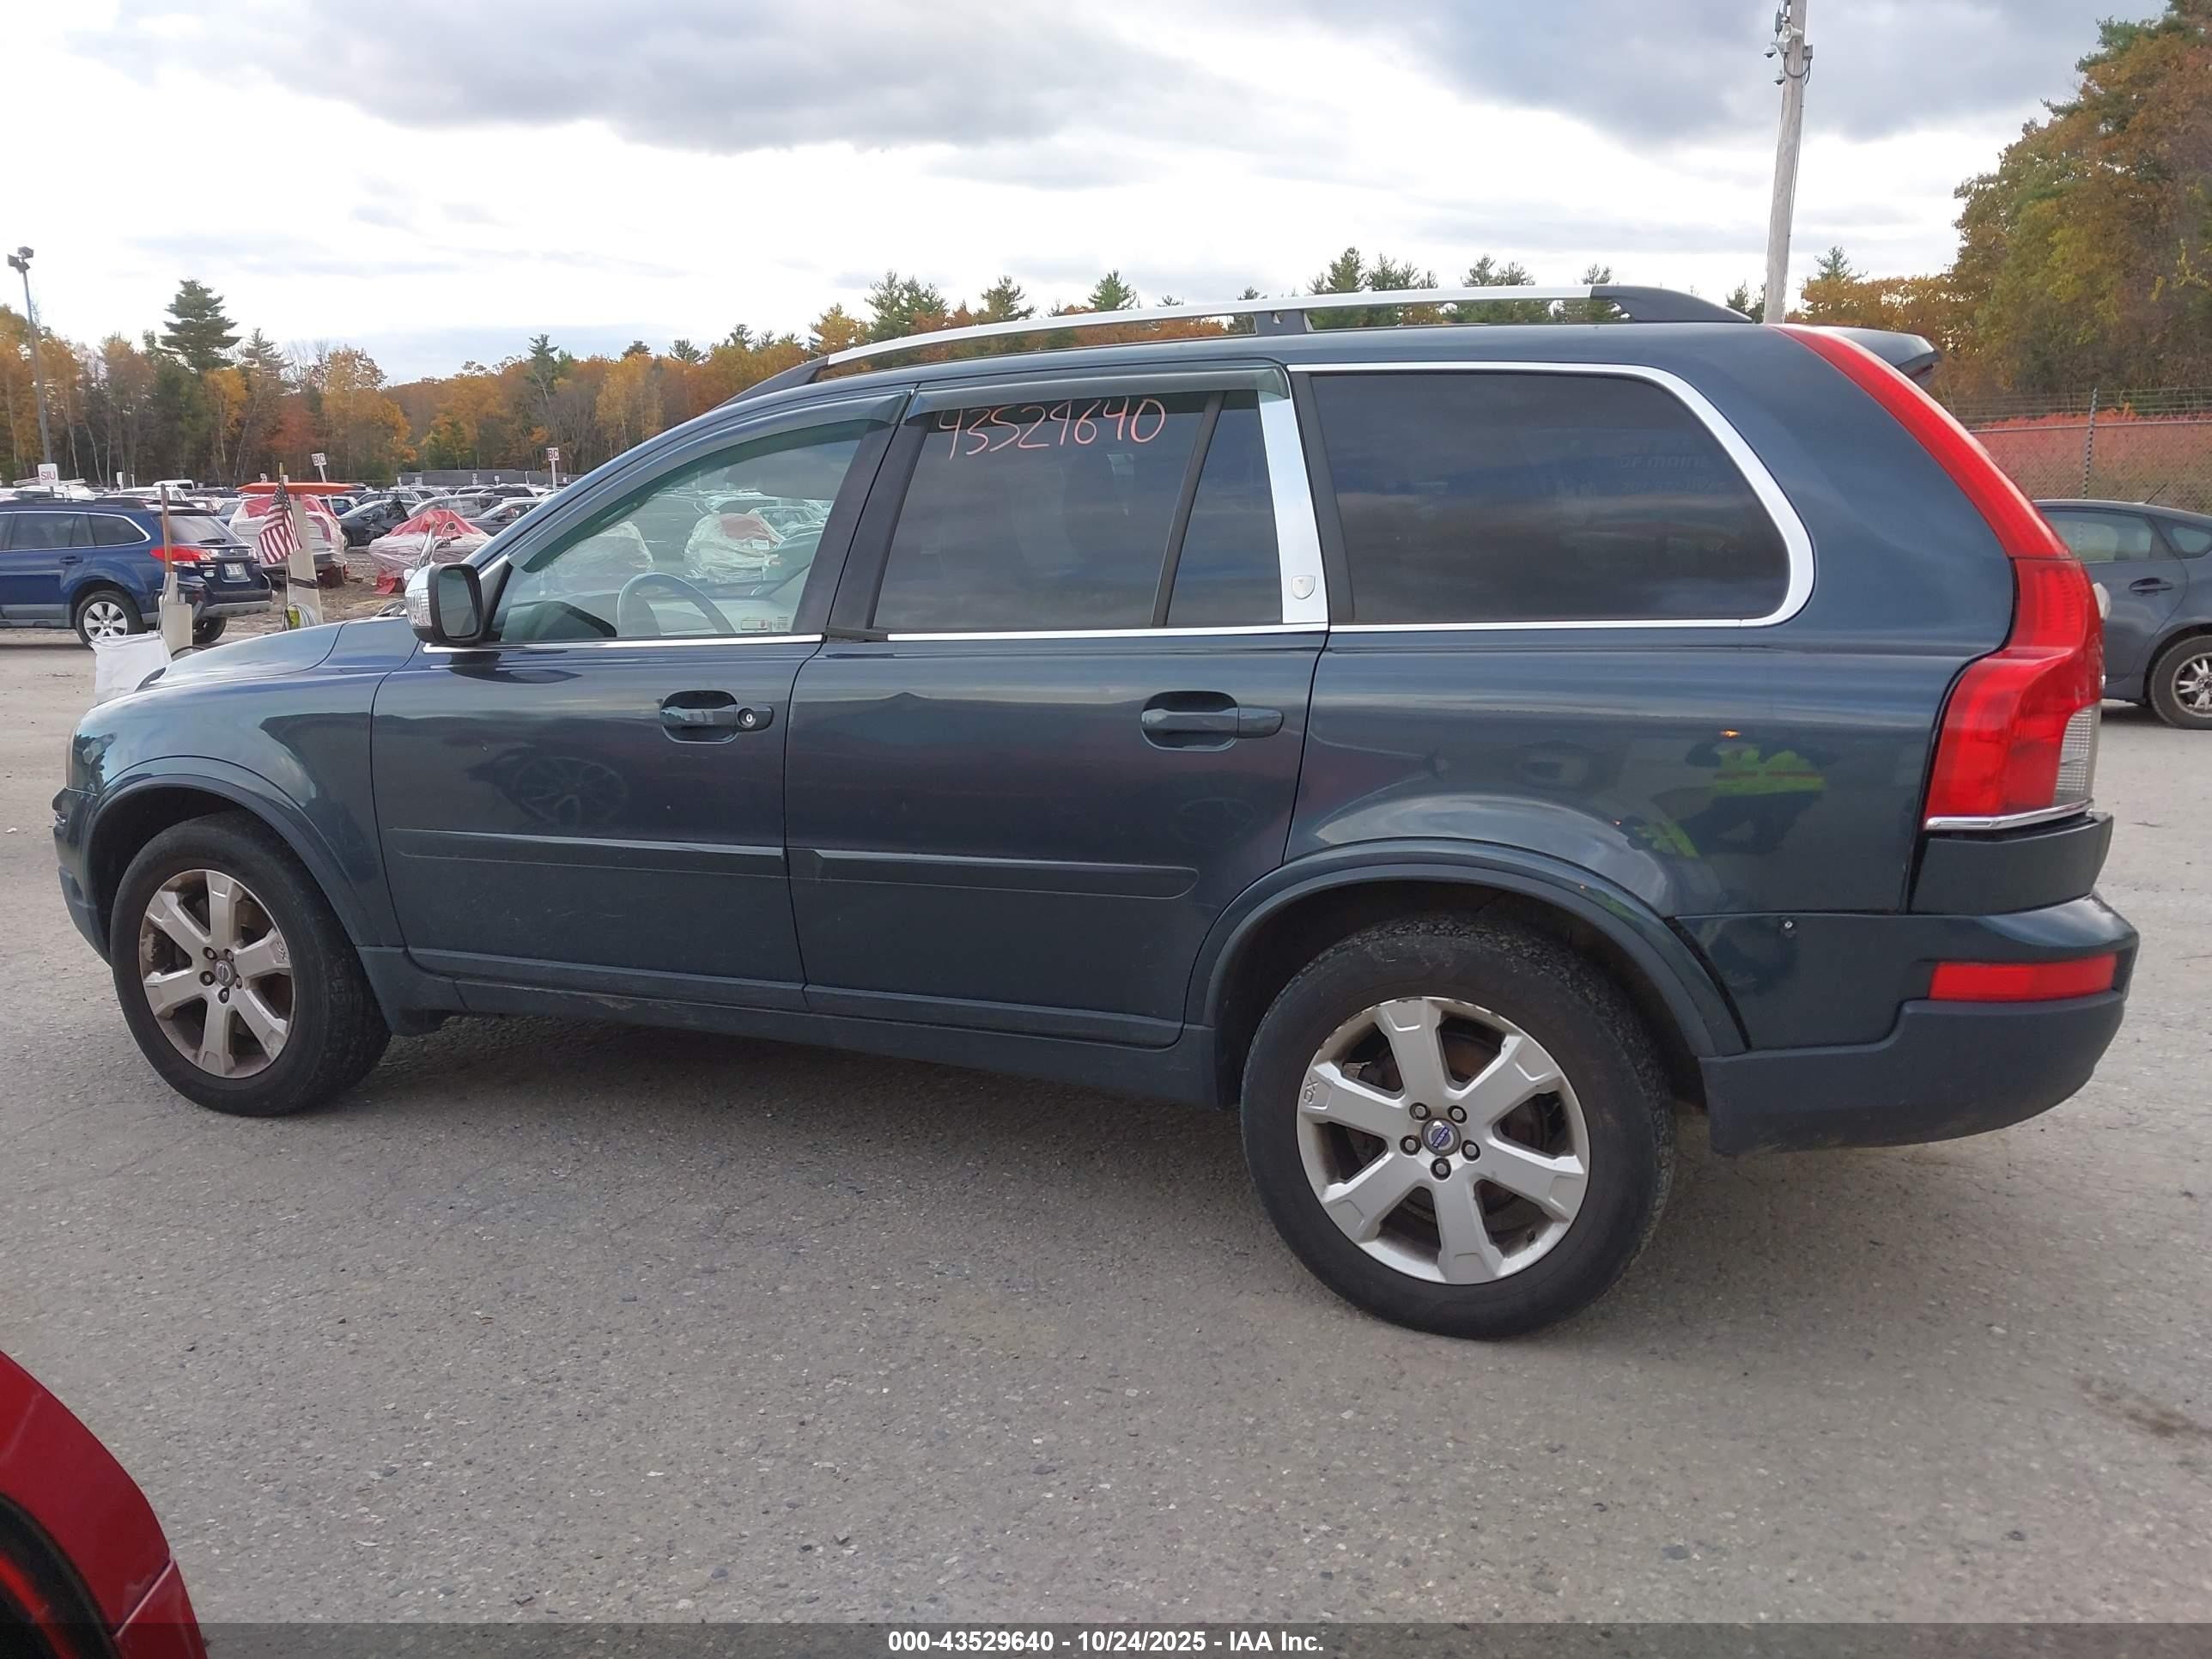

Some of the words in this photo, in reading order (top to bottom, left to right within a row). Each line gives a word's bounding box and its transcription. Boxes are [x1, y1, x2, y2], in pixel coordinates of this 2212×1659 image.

[938, 396, 1166, 460] 43529640
[548, 449, 558, 459] BC
[313, 454, 325, 465] BC
[40, 471, 57, 481] SIU
